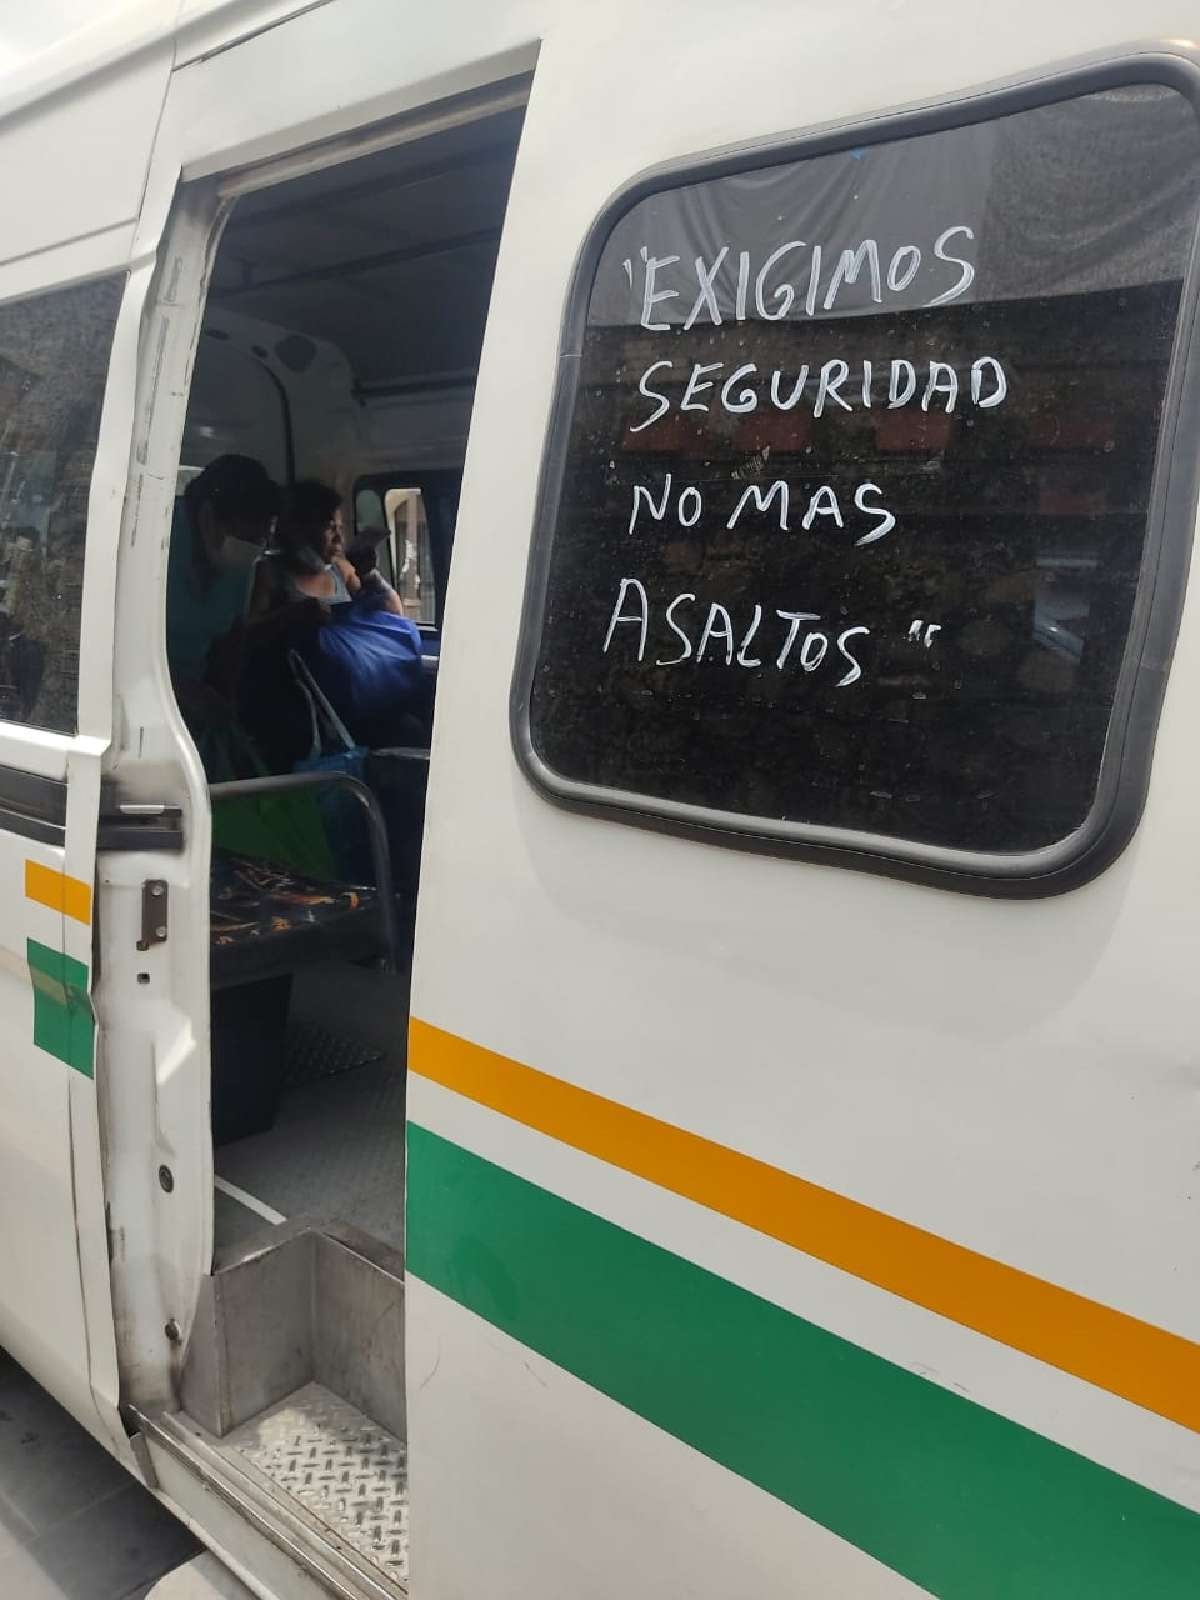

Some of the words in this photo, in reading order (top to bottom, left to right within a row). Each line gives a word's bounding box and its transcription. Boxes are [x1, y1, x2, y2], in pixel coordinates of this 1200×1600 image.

[629, 356, 1008, 432] SEGURIDAD
[629, 473, 702, 535] NO
[727, 479, 897, 547] MAS
[603, 578, 870, 687] ASALTOS
